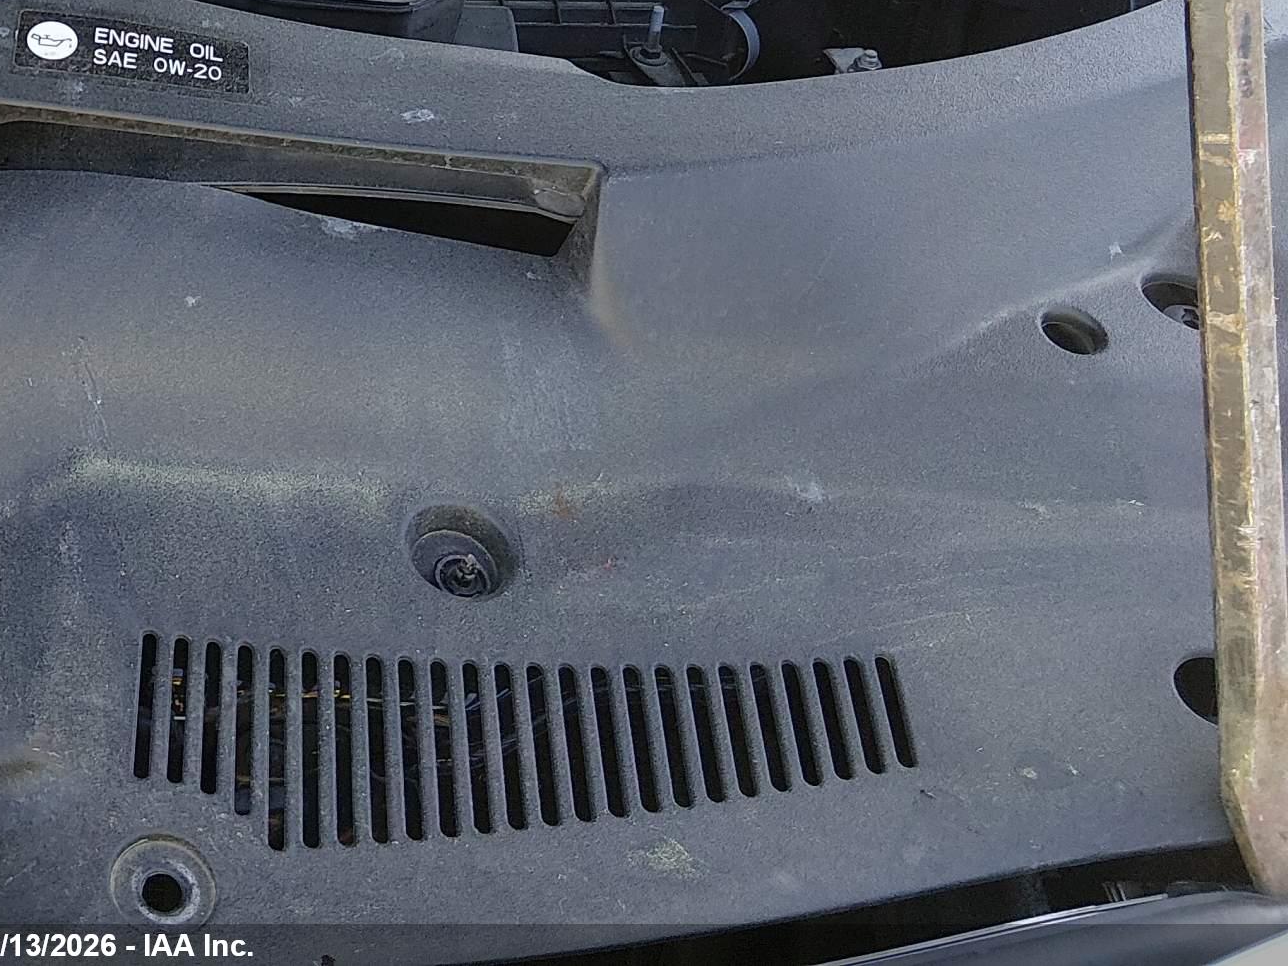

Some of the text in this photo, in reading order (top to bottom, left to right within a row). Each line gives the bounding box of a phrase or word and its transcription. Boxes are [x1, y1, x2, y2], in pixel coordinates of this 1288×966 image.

[94, 27, 223, 62] ENGINE OIL
[93, 48, 222, 80] SAE 0W-20
